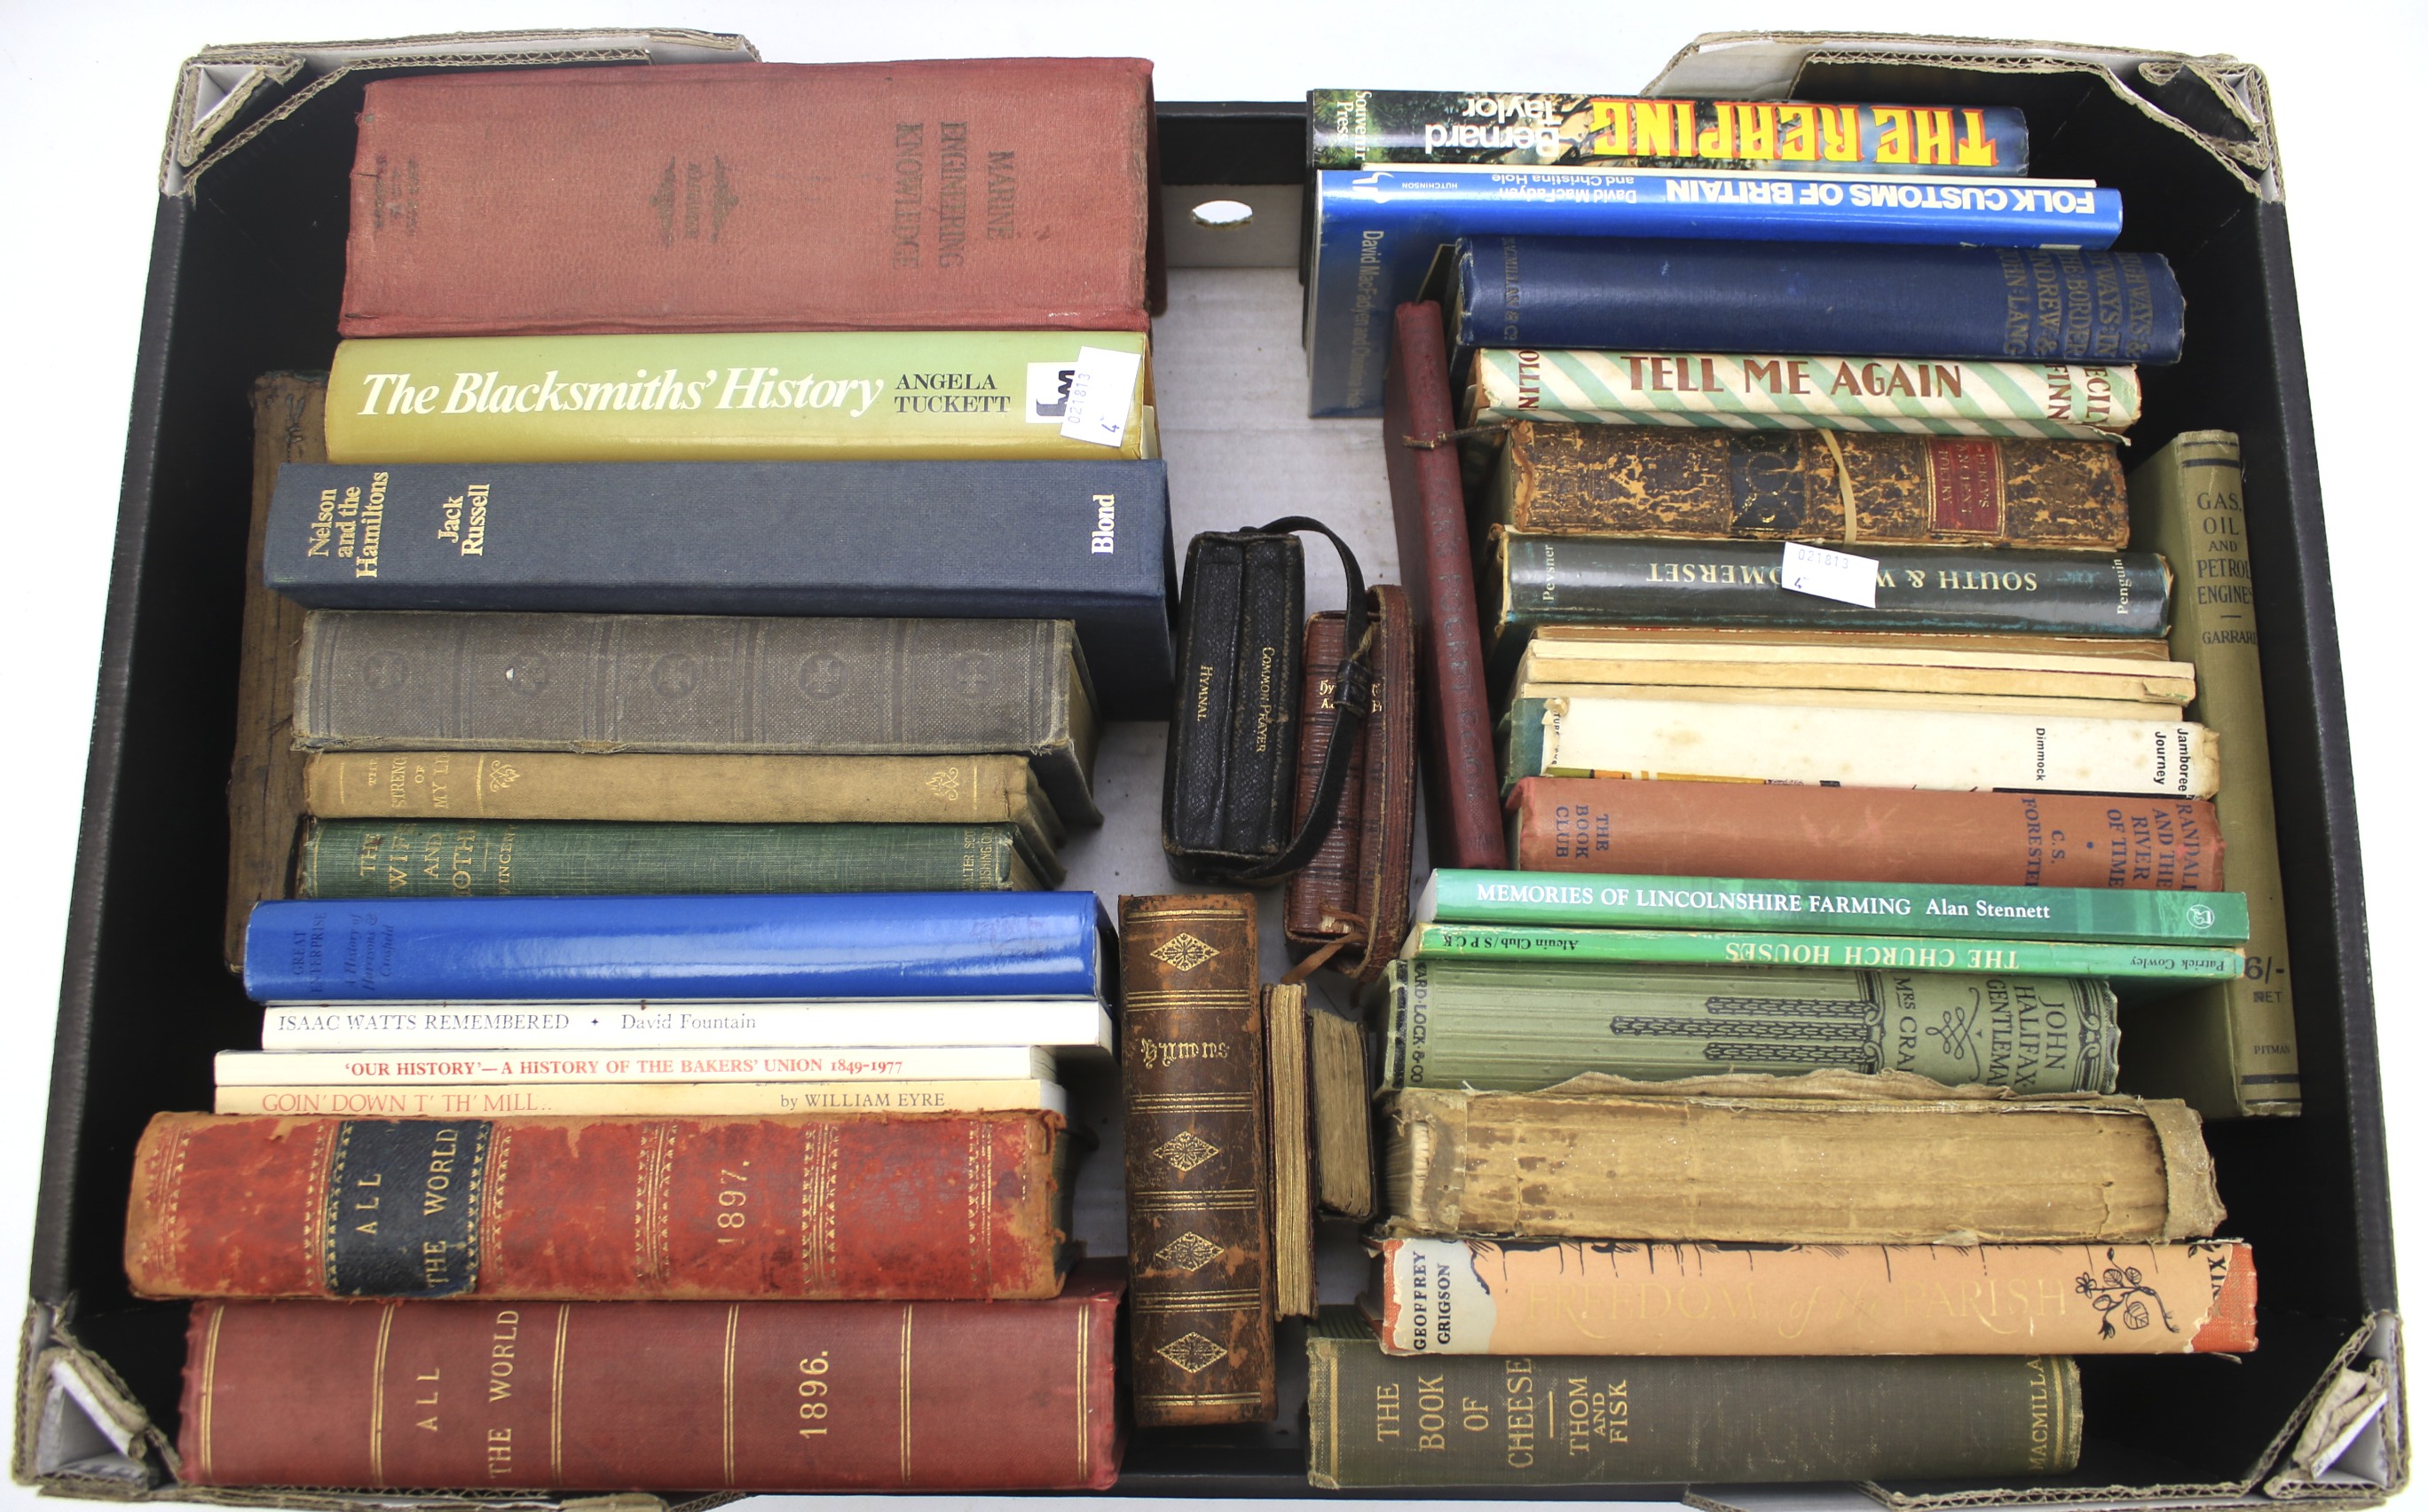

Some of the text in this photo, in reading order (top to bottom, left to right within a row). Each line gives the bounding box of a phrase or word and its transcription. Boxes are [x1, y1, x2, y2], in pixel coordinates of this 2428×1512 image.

[1336, 100, 1353, 142] Press
[1354, 91, 1373, 161] Souvenir
[1462, 96, 1563, 126] Taylor
[1589, 98, 2000, 167] THE REAPING
[1424, 124, 1560, 157] Bernard
[894, 122, 924, 271] KNOWLEDGE
[939, 121, 968, 268] ENGINEERING
[987, 151, 1014, 240] MARINE
[1492, 173, 1635, 187] and Christina Hole
[1499, 186, 1636, 204] David MacFadyen
[1667, 179, 2095, 214] FOLK CUSTOMS OF BRITAIN
[1360, 231, 1384, 264] David
[1351, 266, 1380, 326] MacFadyen
[1504, 311, 1520, 321] &
[2064, 279, 2093, 358] BORDER
[1352, 327, 1371, 345] and
[2004, 295, 2031, 356] LANG
[2095, 332, 2121, 357] IN
[357, 366, 884, 418] The Blacksmiths' History
[895, 373, 997, 391] ANGELA
[1349, 347, 1371, 386] Christina
[1620, 356, 1963, 398] TELL ME AGAIN
[2046, 363, 2072, 420] FINN
[895, 395, 1012, 414] TUCKETT
[1067, 372, 1091, 425] 021813
[1937, 449, 1953, 504] POETRY
[2197, 492, 2243, 512] GAS,
[308, 488, 337, 558] Nelson
[335, 485, 362, 559] and the
[356, 471, 389, 579] Hamiltons
[438, 495, 464, 543] Jack
[461, 484, 491, 557] Russell
[1091, 493, 1115, 555] Blond
[2203, 517, 2239, 535] OIL
[1798, 547, 1849, 570] 021813
[2208, 540, 2237, 552] AND
[1542, 544, 1555, 602] Pevsner
[1906, 570, 1926, 588] &
[1939, 571, 2038, 591] SOUTH
[2111, 558, 2132, 615] Penguin
[1197, 665, 1214, 721] HYMNAL
[1257, 647, 1275, 753] COMMON PRAYER
[368, 759, 378, 786] THE
[414, 765, 426, 784] OF
[2036, 728, 2046, 782] Dimmock
[2153, 731, 2167, 785] Journey
[2177, 728, 2189, 792] Jamboree
[432, 781, 448, 809] MY
[359, 833, 381, 878] THE
[423, 834, 443, 878] AND
[1556, 806, 1569, 857] CLUB
[1575, 804, 1590, 859] BOOK
[1596, 812, 1611, 851] THE
[2050, 829, 2066, 865] C.S.
[2107, 808, 2128, 887] OF TIME
[2131, 815, 2152, 881] RIVER
[2152, 808, 2175, 888] AND THE
[1477, 883, 1912, 916] MEMORIES OF LINCOLNSHIRE FARMING
[1925, 898, 2051, 919] Alan Stennett
[291, 929, 306, 975] GREAT
[311, 912, 327, 993] ENTERPRISE
[343, 929, 360, 974] History
[360, 931, 376, 991] Harrisons
[380, 925, 395, 978] Crosfield
[1535, 938, 1579, 951] Alcuin
[1725, 942, 2021, 969] THE CHURCH HOUSES
[2130, 955, 2225, 972] Patrick Cowley
[278, 1013, 569, 1031] ISAAC WATTS REMEMBERED
[621, 1012, 756, 1029] David Fountain
[2039, 996, 2069, 1070] JOHN
[345, 1059, 903, 1076] 'OUR HISTORY OF THE BAKERS' UNION 1849-1977
[2254, 1044, 2290, 1055] PITMAN
[262, 1093, 477, 1112] GOIN' DOWN T' TH'
[781, 1092, 945, 1111] by WILLIAM EYRE
[356, 1173, 382, 1235] ALL
[423, 1128, 459, 1288] THE WORLD
[1413, 1250, 1427, 1351] GEOFFREY
[1437, 1263, 1450, 1345] GRIGSON
[1778, 1286, 1821, 1339] of
[1901, 1278, 2067, 1335] PARISH
[415, 1366, 440, 1431] ALL
[488, 1310, 520, 1479] THE WORLD
[799, 1351, 830, 1440] 1896.
[1377, 1382, 1400, 1443] THE
[1418, 1374, 1446, 1453] BOOK
[1463, 1396, 1490, 1431] OF
[1507, 1358, 1534, 1469] CHEESE
[1568, 1375, 1590, 1456] THOM
[1593, 1392, 1605, 1437] AND
[1609, 1380, 1628, 1445] FISK
